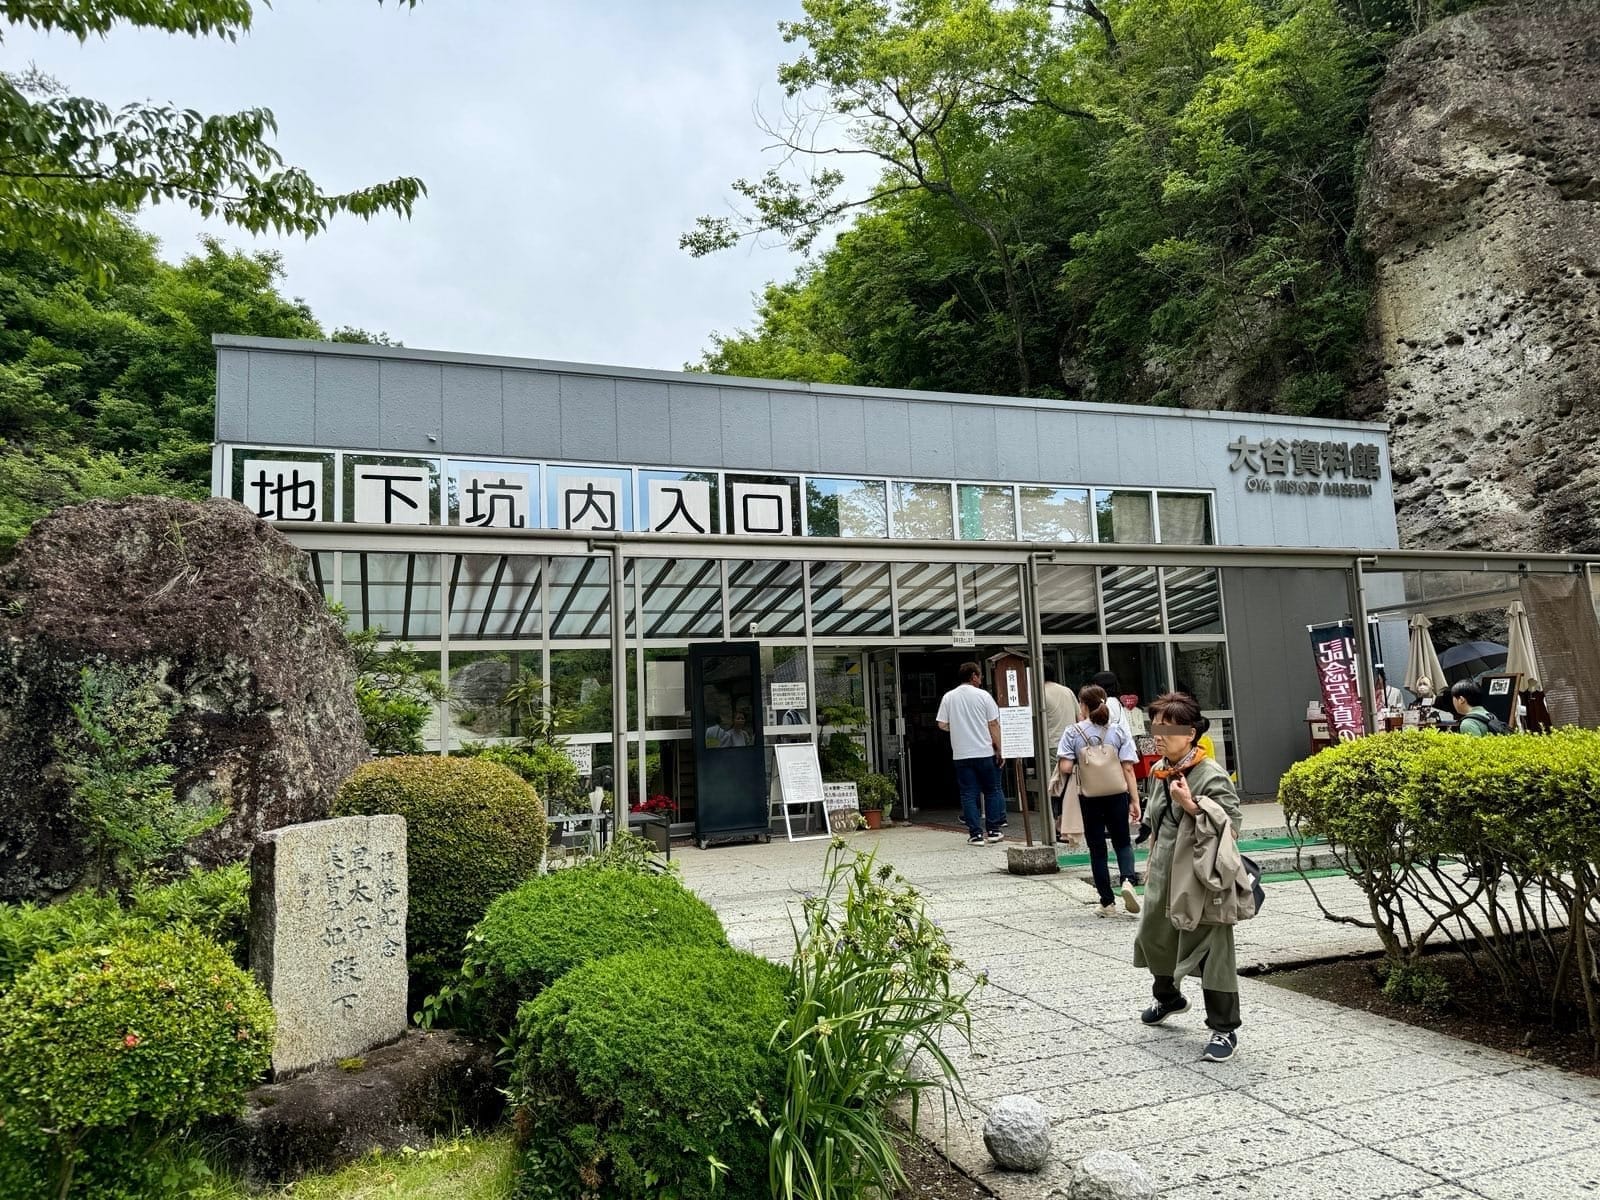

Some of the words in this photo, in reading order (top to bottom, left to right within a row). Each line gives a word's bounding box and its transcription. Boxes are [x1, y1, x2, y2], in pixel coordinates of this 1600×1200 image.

[1228, 435, 1381, 480] 大谷資料館
[251, 469, 783, 533] 地下坑内入口
